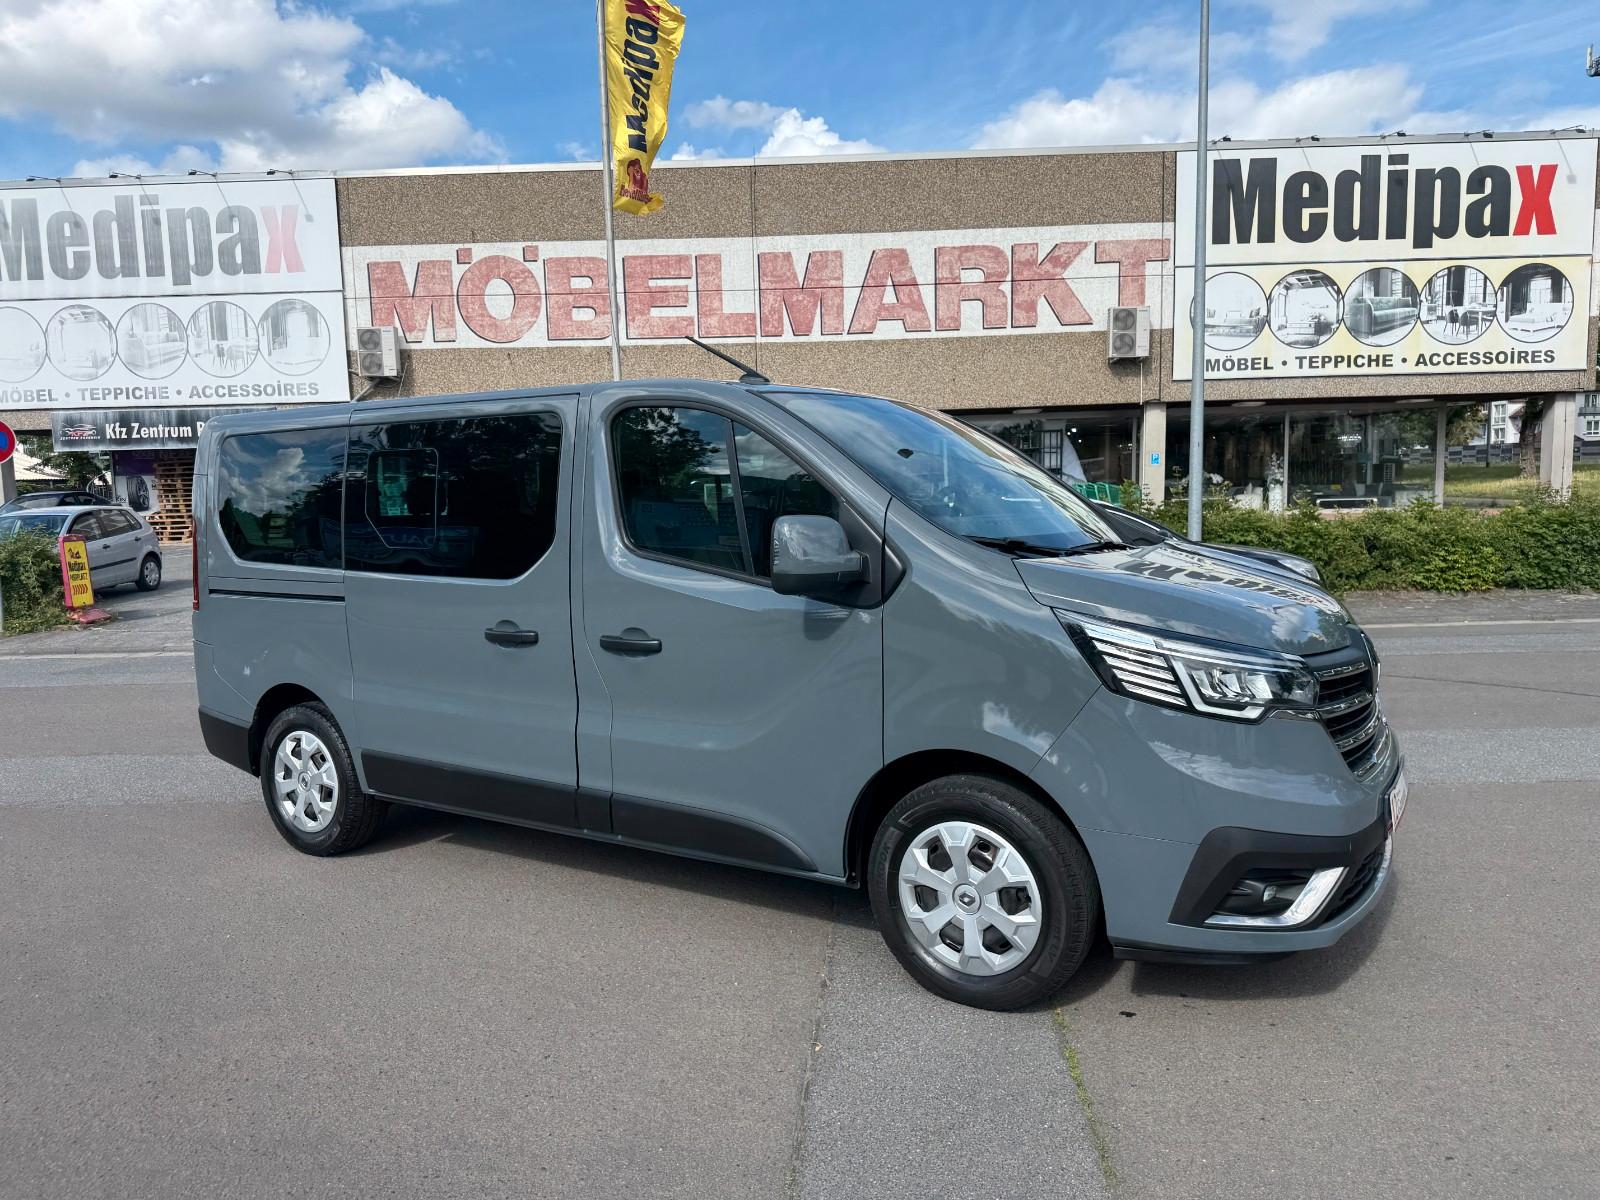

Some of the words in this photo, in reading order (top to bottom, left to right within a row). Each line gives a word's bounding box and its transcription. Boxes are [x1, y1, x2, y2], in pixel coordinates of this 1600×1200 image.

[621, 0, 660, 153] Medipax
[0, 194, 305, 286] Medipax
[1212, 154, 1558, 249] Medipax
[367, 238, 1171, 344] MÖBELMARKT
[77, 385, 169, 400] TEPPICHE
[1205, 355, 1274, 372] MÖBEL
[1295, 353, 1394, 370] TEPPICHE
[105, 422, 128, 439] Kfz
[131, 422, 192, 438] Zentrum
